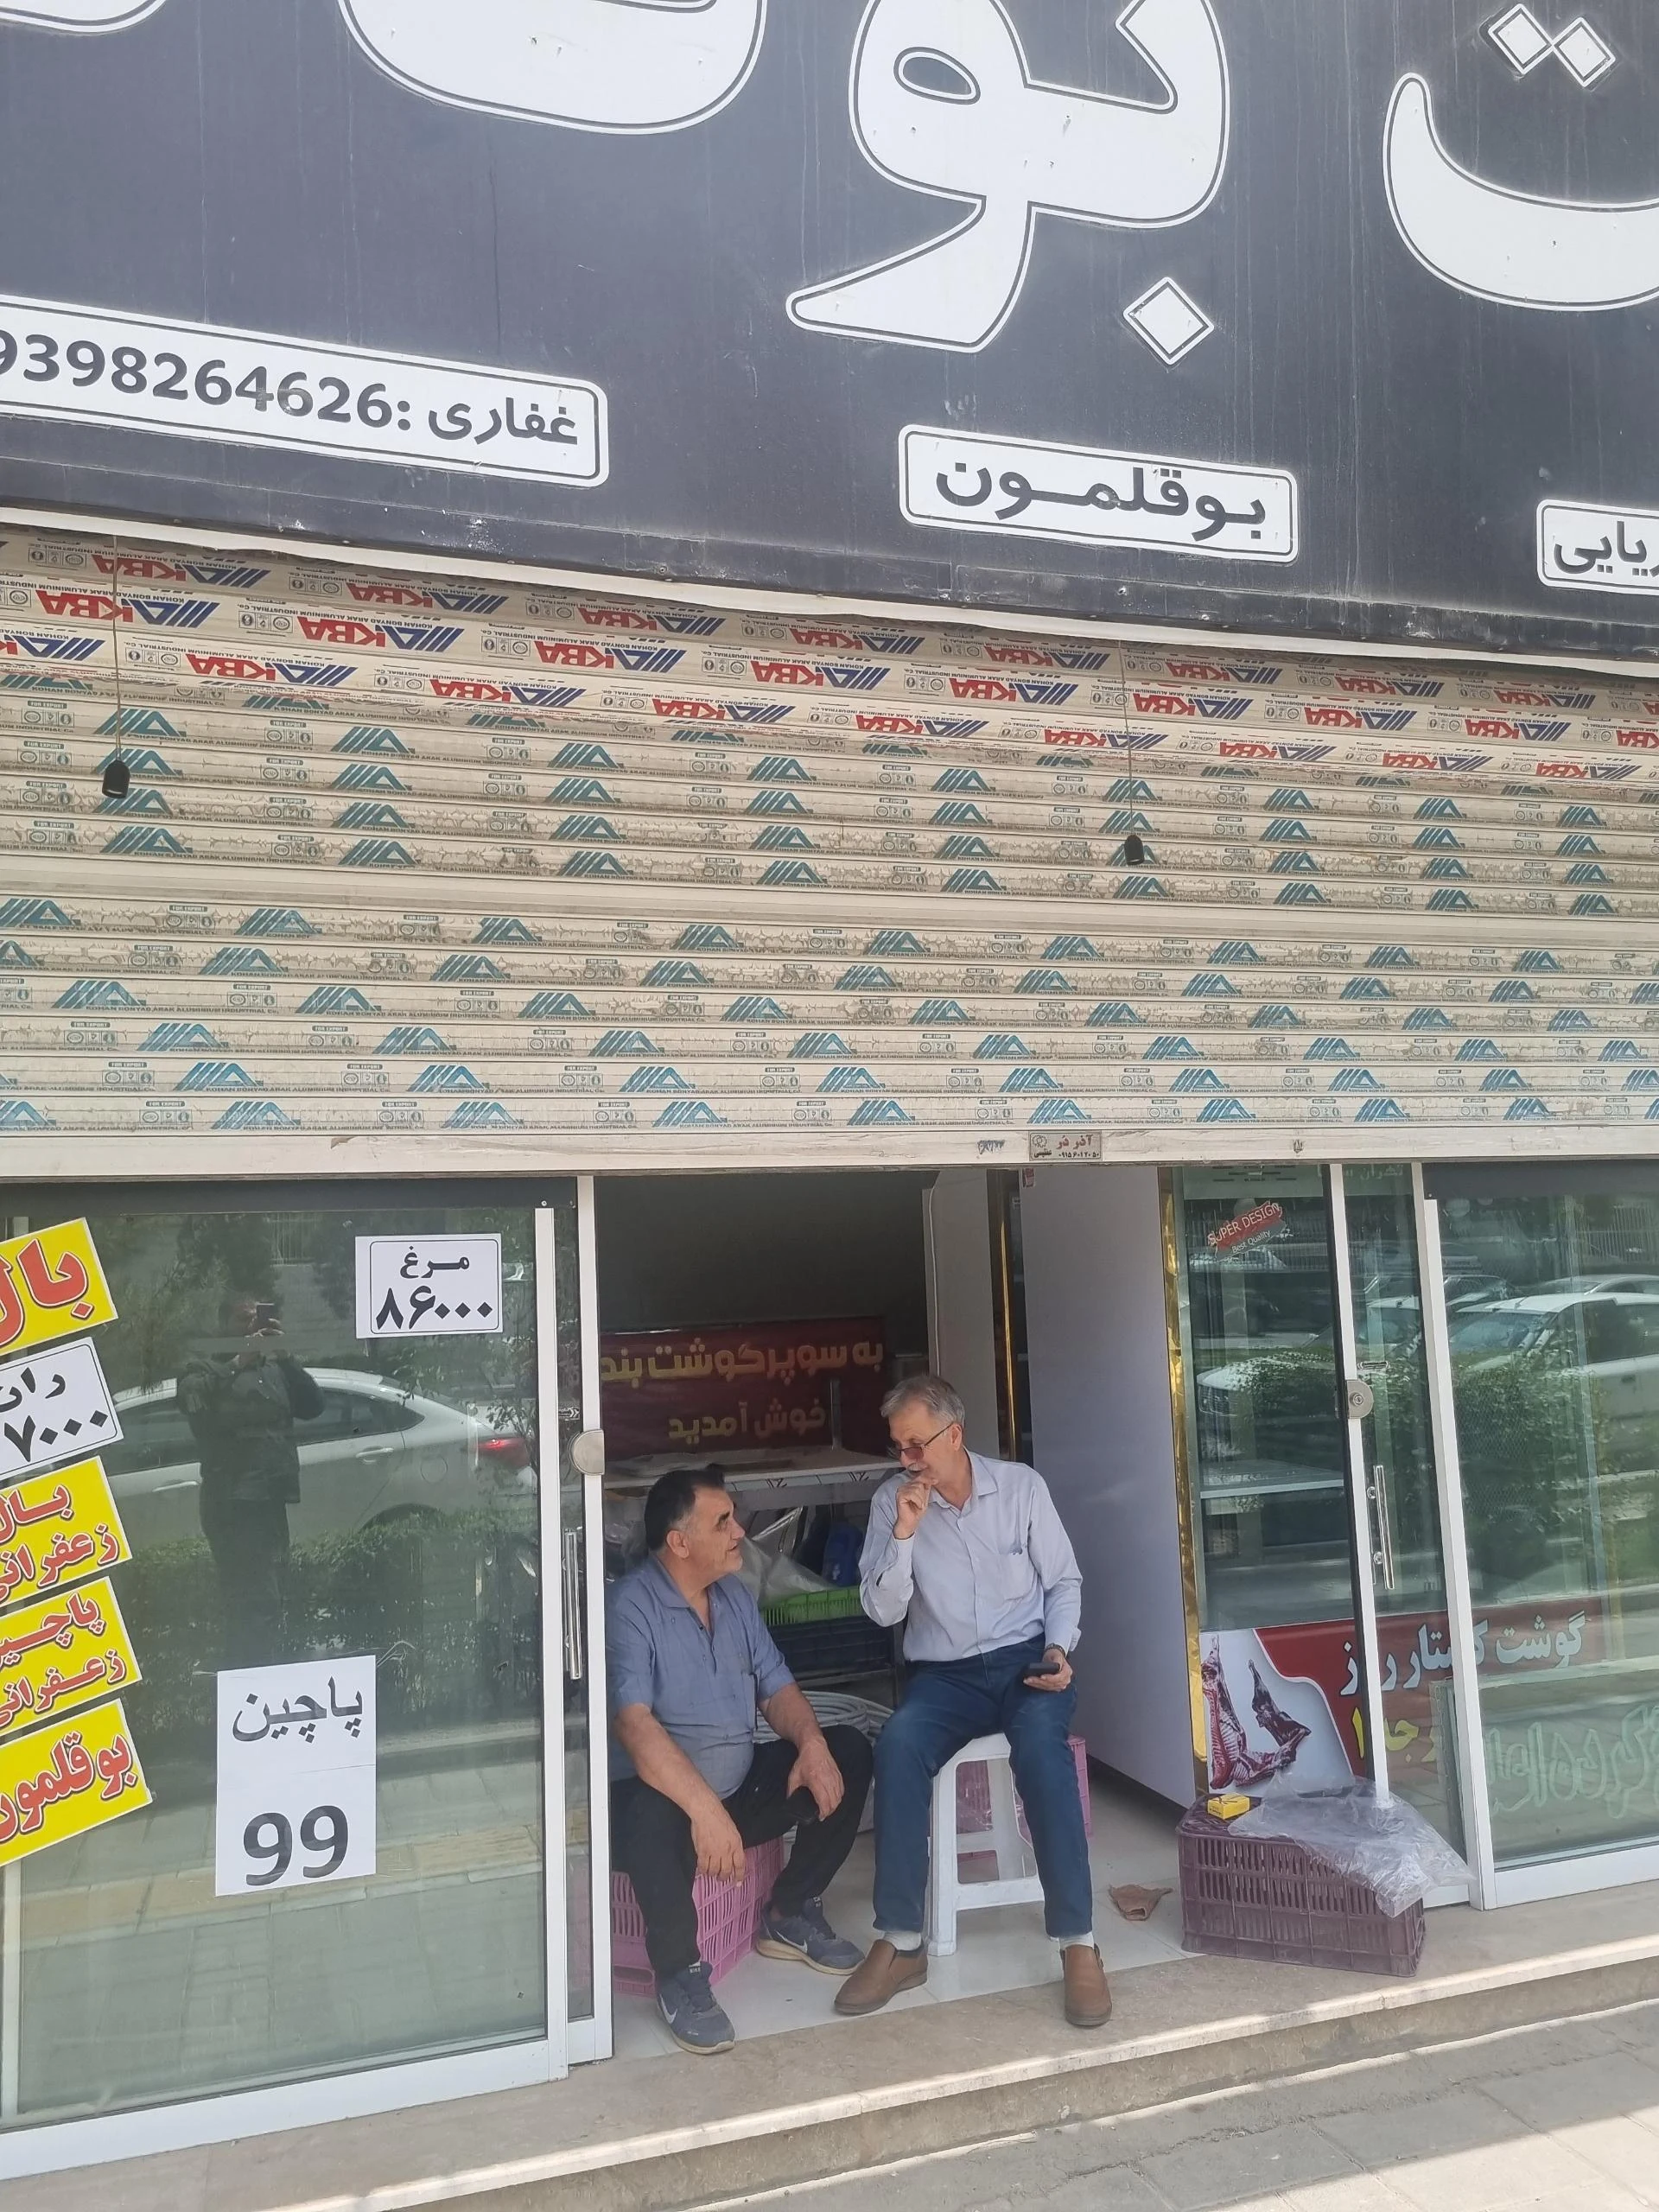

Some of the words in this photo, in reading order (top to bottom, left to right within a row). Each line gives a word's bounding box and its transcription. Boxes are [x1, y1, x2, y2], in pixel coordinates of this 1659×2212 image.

[428, 397, 579, 448] غفاری
[936, 456, 1267, 542] بوقلمون
[1206, 1221, 1242, 1246] SUPER
[1241, 1202, 1281, 1228] DESIGN
[1231, 1241, 1246, 1253] Best
[1247, 1230, 1271, 1247] Quality
[399, 1245, 470, 1279] مرغ
[376, 1285, 493, 1330] ۸۶۰۰۰
[668, 1402, 748, 1445] آمدید
[753, 1397, 825, 1440] خوش
[0, 1523, 120, 1603] زعفران
[0, 1592, 105, 1672] پاچی
[1496, 1611, 1586, 1668] گوشت
[0, 1649, 126, 1727] زعفران
[232, 1676, 363, 1744] پاچین
